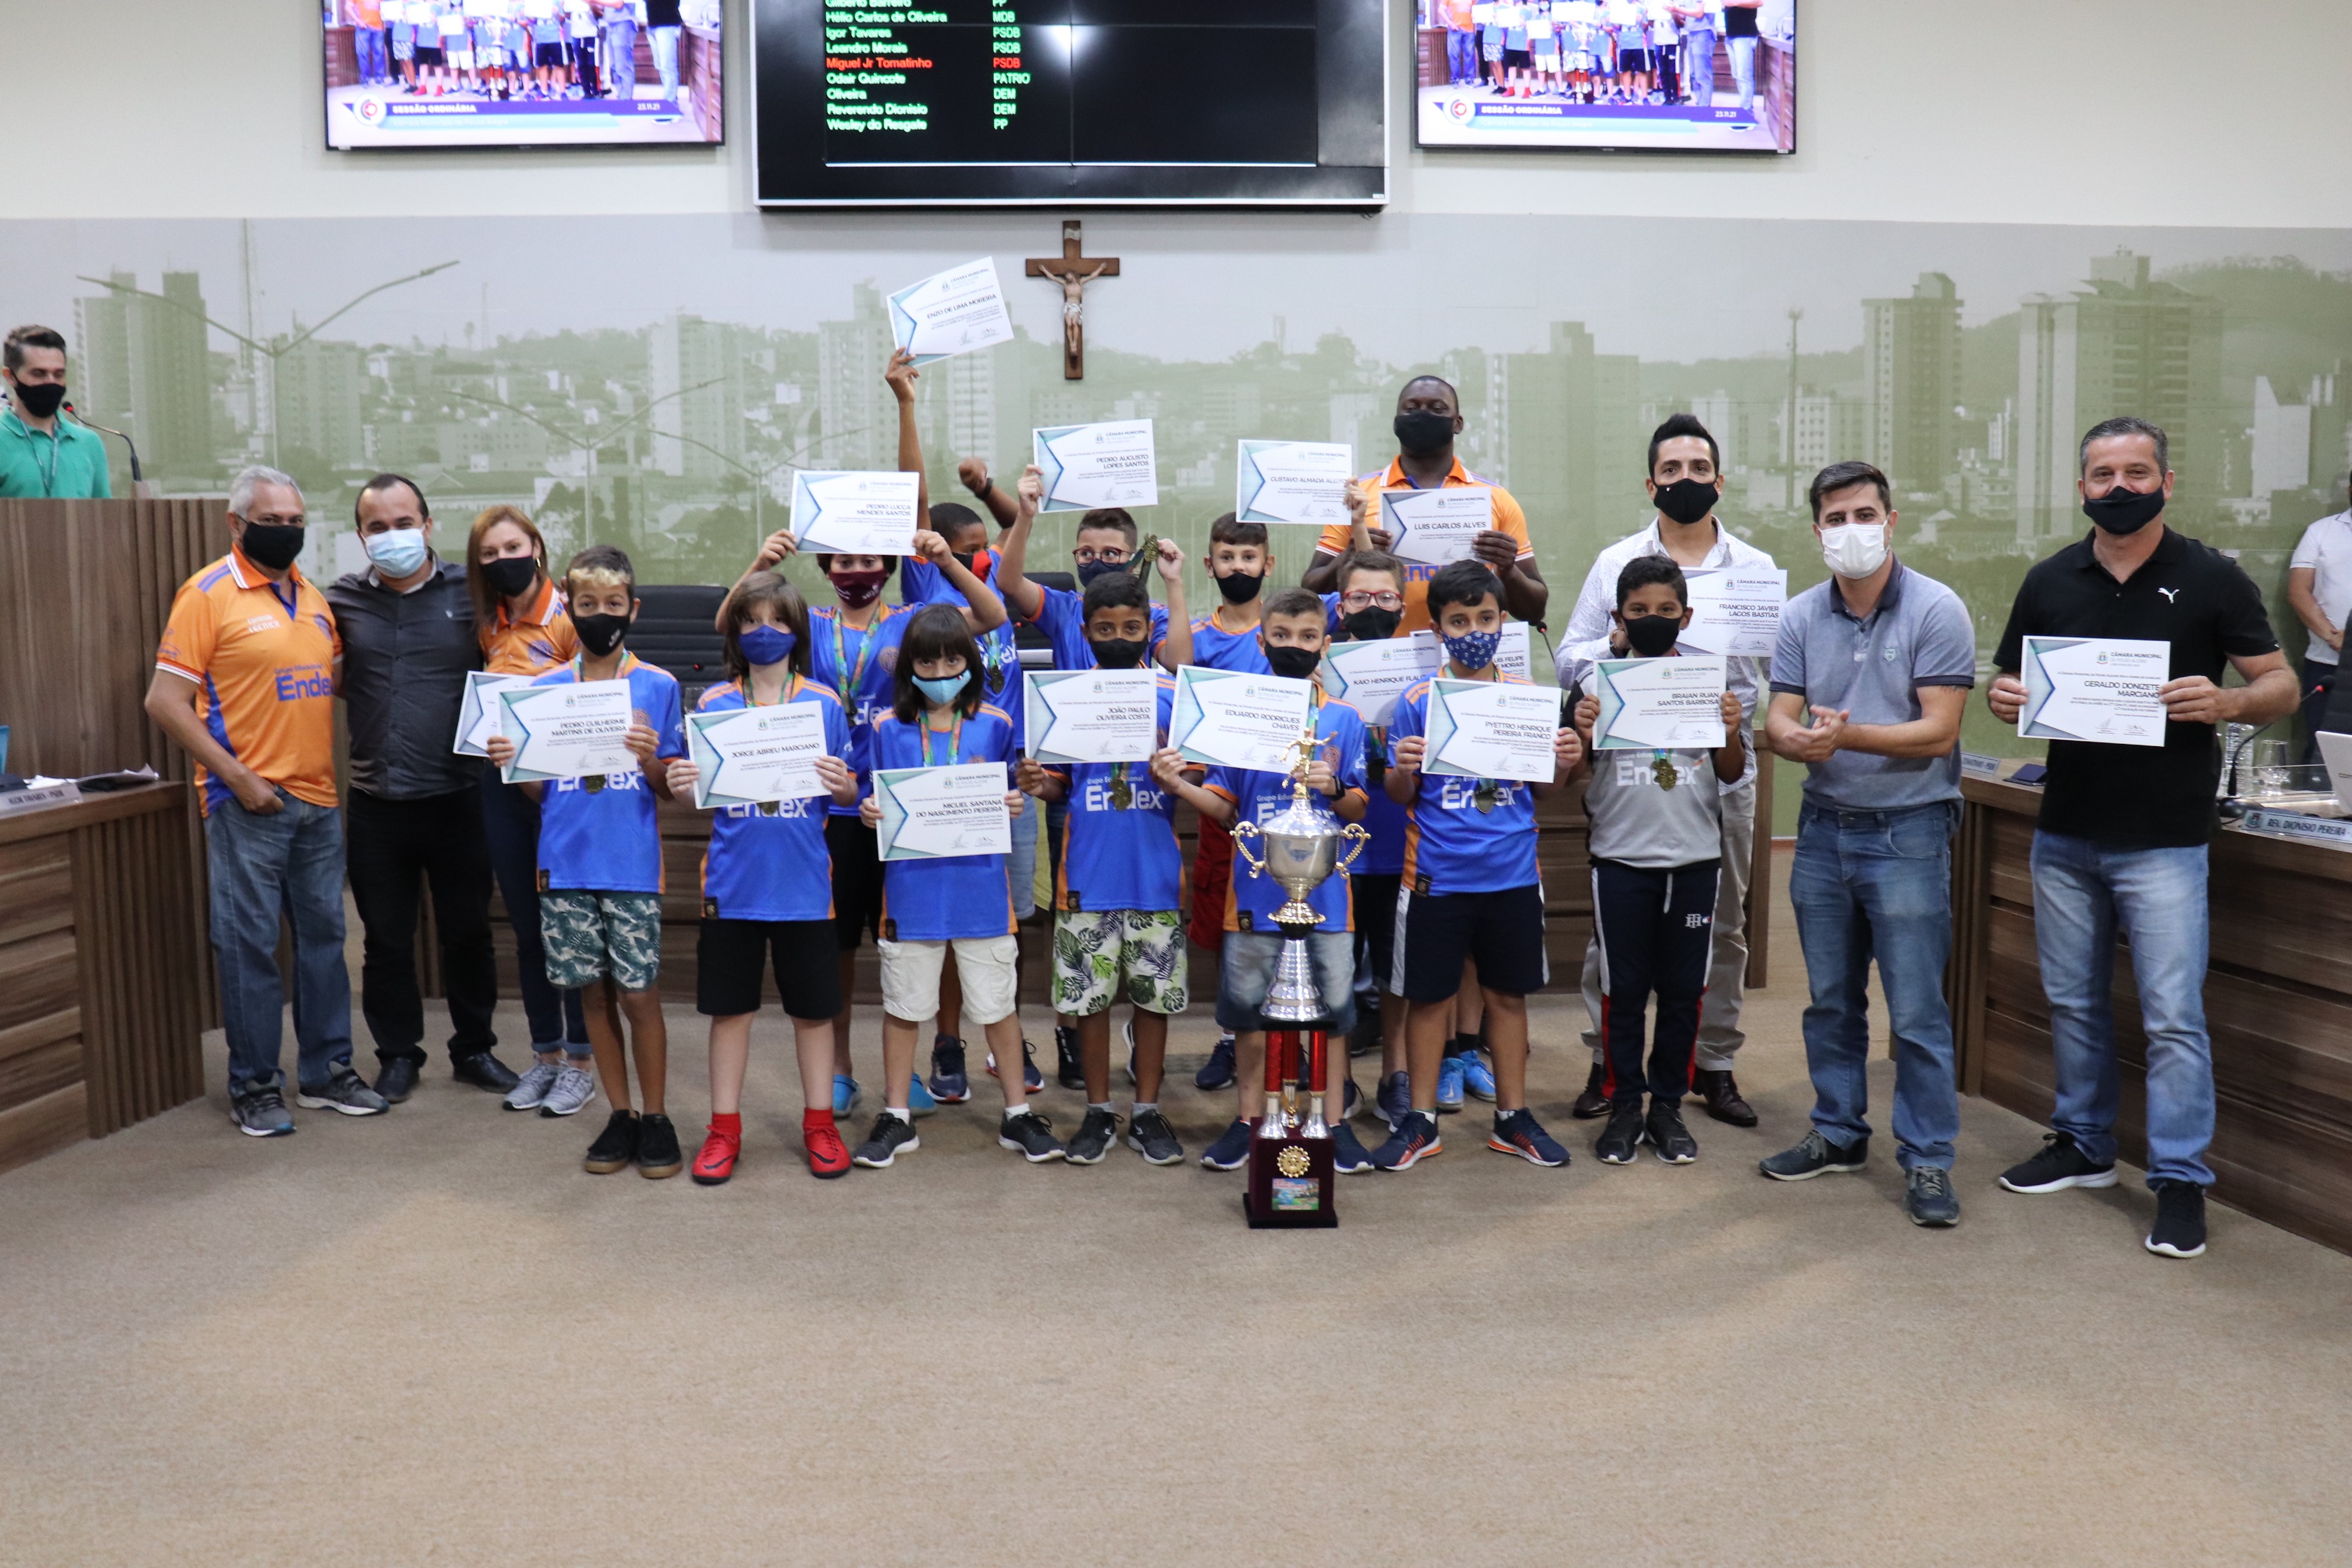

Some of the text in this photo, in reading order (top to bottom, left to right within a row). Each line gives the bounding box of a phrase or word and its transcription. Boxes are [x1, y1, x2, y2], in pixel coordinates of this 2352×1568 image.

[855, 11, 890, 22] Carlos
[891, 12, 906, 22] de
[907, 11, 948, 22] Oliveira
[992, 11, 1015, 22] MDB
[826, 27, 892, 40] Igor Tavares
[993, 27, 1021, 38] PSDB
[826, 42, 908, 54] Leandro Morais
[993, 42, 1021, 54] PSDB
[826, 57, 933, 71] Miguel Jr Tomatinho
[993, 57, 1021, 69] PSDB
[827, 73, 856, 84] Odair
[994, 73, 1031, 84] PATRIO
[827, 89, 867, 100] Oliveira
[994, 89, 1016, 100] DEM
[392, 103, 477, 113] SESSÃO ORDINÁRIA
[827, 103, 884, 115] Reverendo
[994, 103, 1016, 115] DEM
[1481, 105, 1563, 115] SESSÃO ORDINÁRIA
[827, 119, 927, 132] Wesley do Resgate
[994, 119, 1008, 130] PP
[927, 310, 943, 318] ENZO
[954, 302, 968, 311] LIMA
[969, 294, 997, 305] MOREIRA
[276, 671, 334, 701] Ende
[1225, 709, 1300, 723] EDUARDO RODRIGUES
[1517, 724, 1551, 733] HENRIQUE
[782, 743, 819, 753] MARCIANO
[1442, 781, 1524, 809] Enex
[727, 798, 812, 818] Enex
[928, 808, 972, 817] NASCIMENTO
